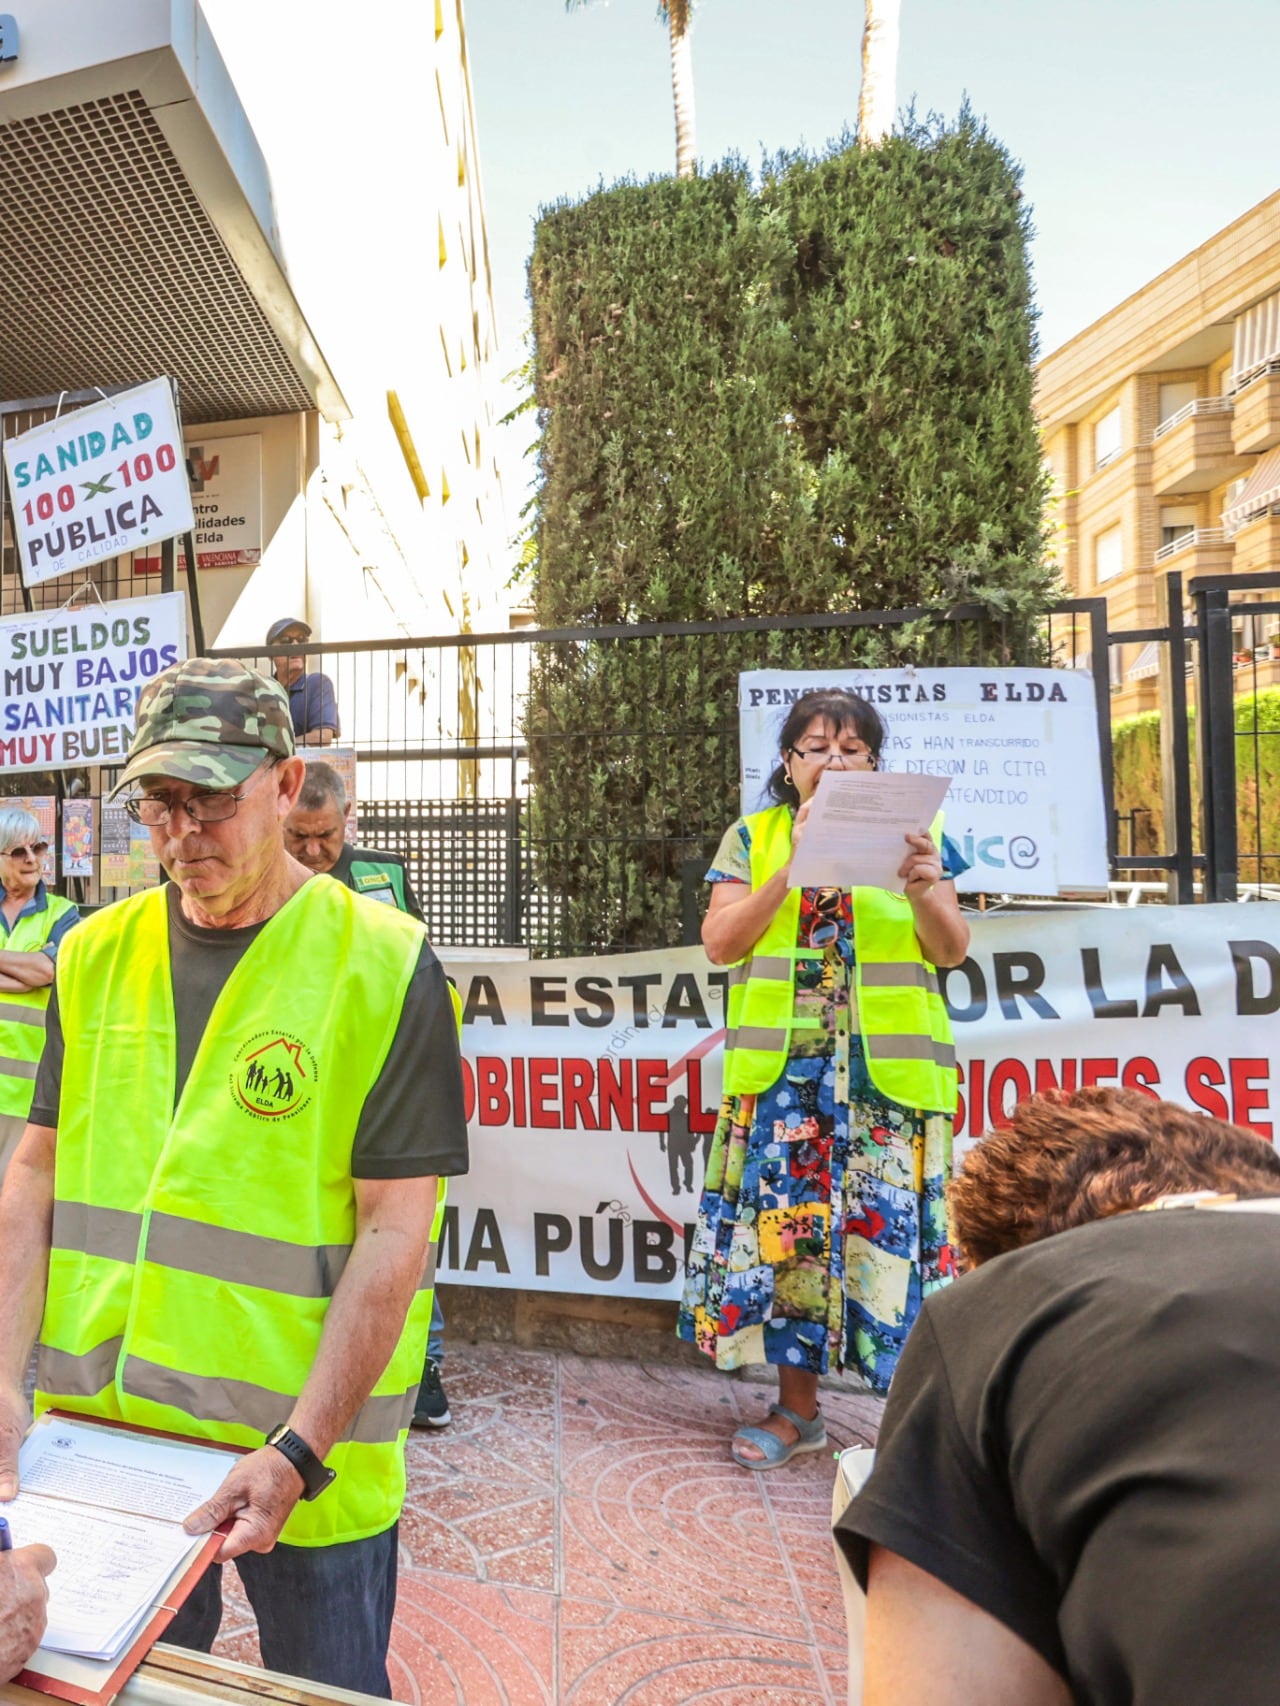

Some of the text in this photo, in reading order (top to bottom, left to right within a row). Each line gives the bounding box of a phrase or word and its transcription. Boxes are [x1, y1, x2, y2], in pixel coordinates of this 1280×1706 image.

[14, 412, 153, 488] SANIDAD
[22, 484, 75, 526] 100
[116, 443, 176, 488] 100
[193, 503, 219, 514] ntro
[195, 516, 246, 530] lidades
[28, 494, 163, 567] PÚBLICA
[196, 533, 224, 545] Elda
[34, 535, 129, 579] Y DE CALIDAD
[11, 616, 150, 660] SUELDOS
[4, 644, 178, 697] MUY BAJOS
[749, 682, 1068, 707] PENNISTAS ELDA
[883, 712, 996, 723] SIONISTAS ELDA
[62, 724, 135, 761] BUEN
[883, 735, 1040, 750] IAS HAN TRANSCURRIDO
[906, 759, 965, 775] DIERON
[973, 760, 989, 775] LA
[1003, 760, 1047, 776] CITA
[458, 975, 507, 1025] A
[937, 951, 1062, 1023] OR
[1081, 943, 1202, 1019] LA
[256, 1097, 274, 1108] ELDA
[686, 1059, 719, 1133] L
